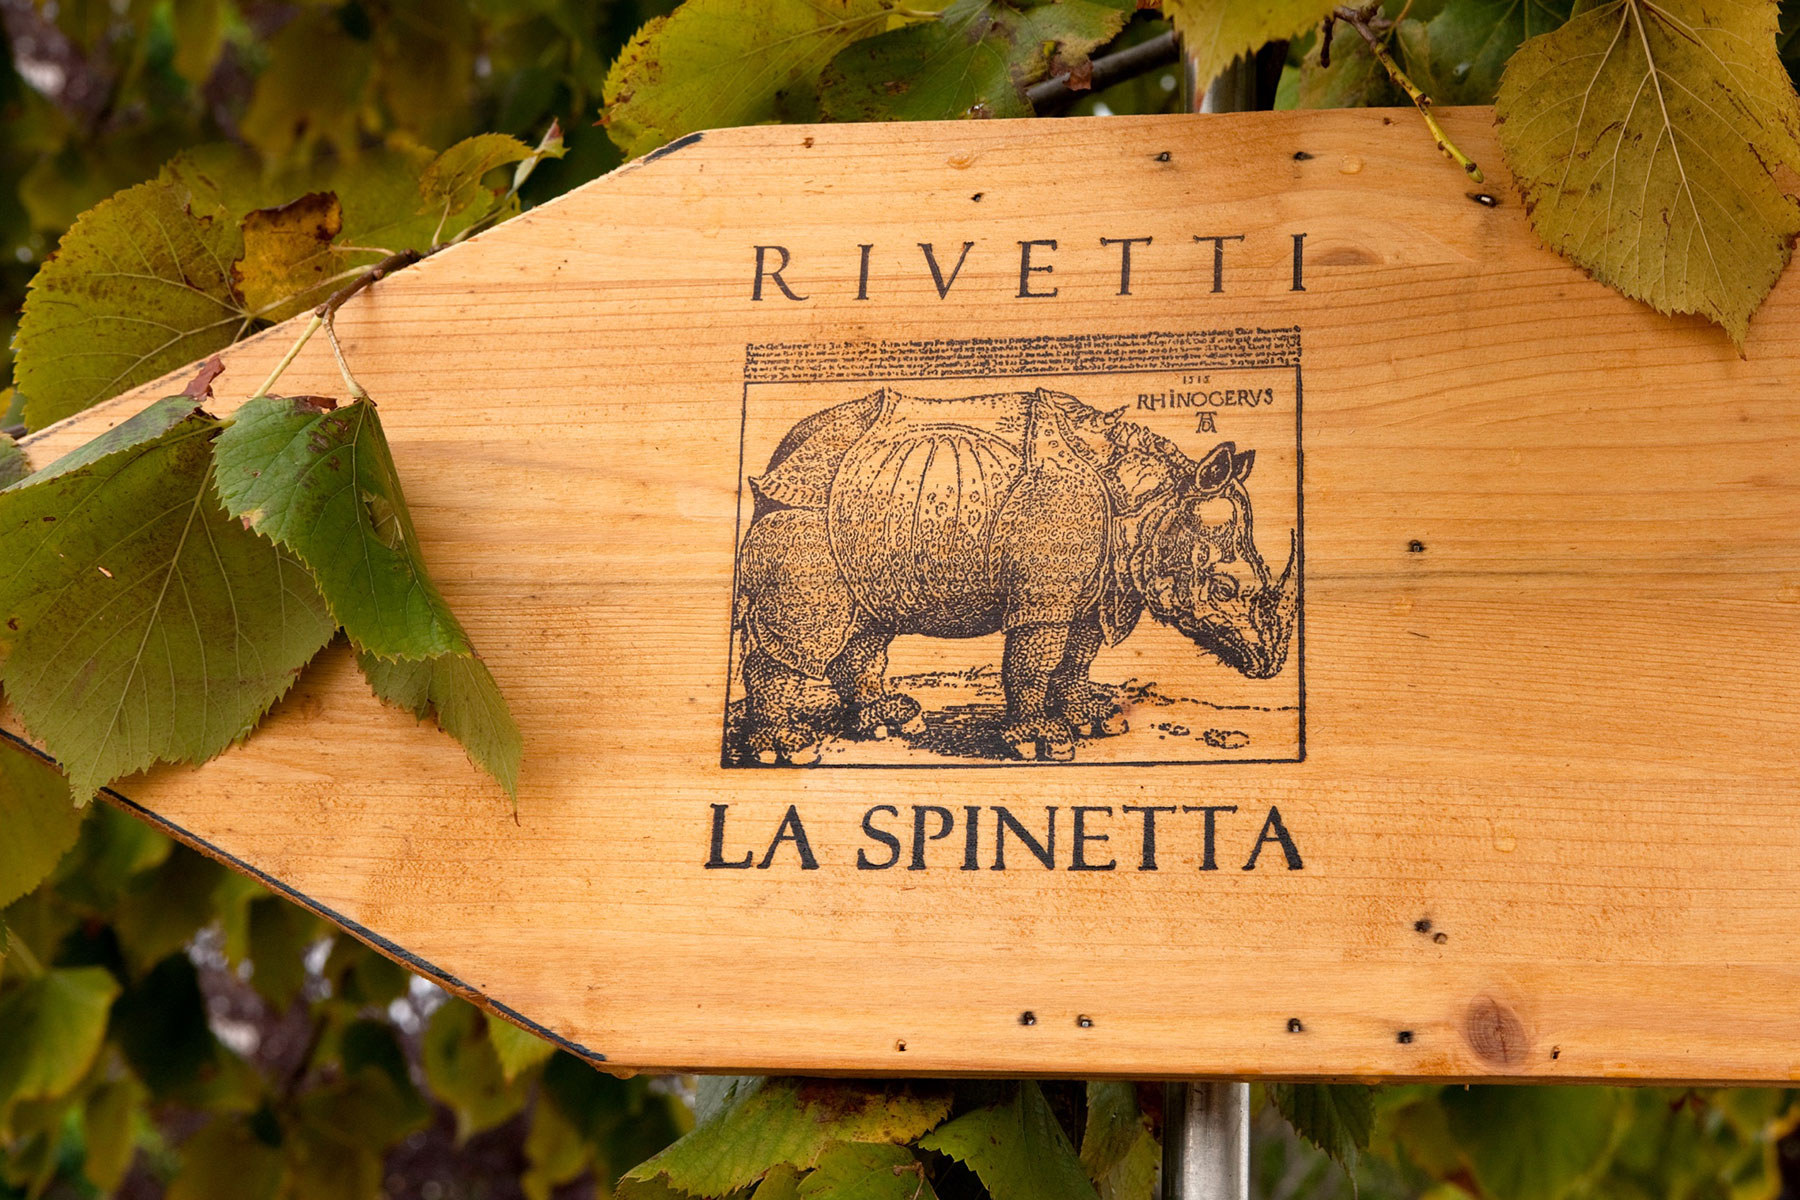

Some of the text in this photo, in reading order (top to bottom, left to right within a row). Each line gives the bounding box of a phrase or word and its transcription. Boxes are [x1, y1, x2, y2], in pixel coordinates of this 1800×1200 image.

[751, 232, 1307, 301] RIVETTI
[1182, 375, 1211, 385] 1515
[703, 803, 1304, 871] LA SPINETTA
